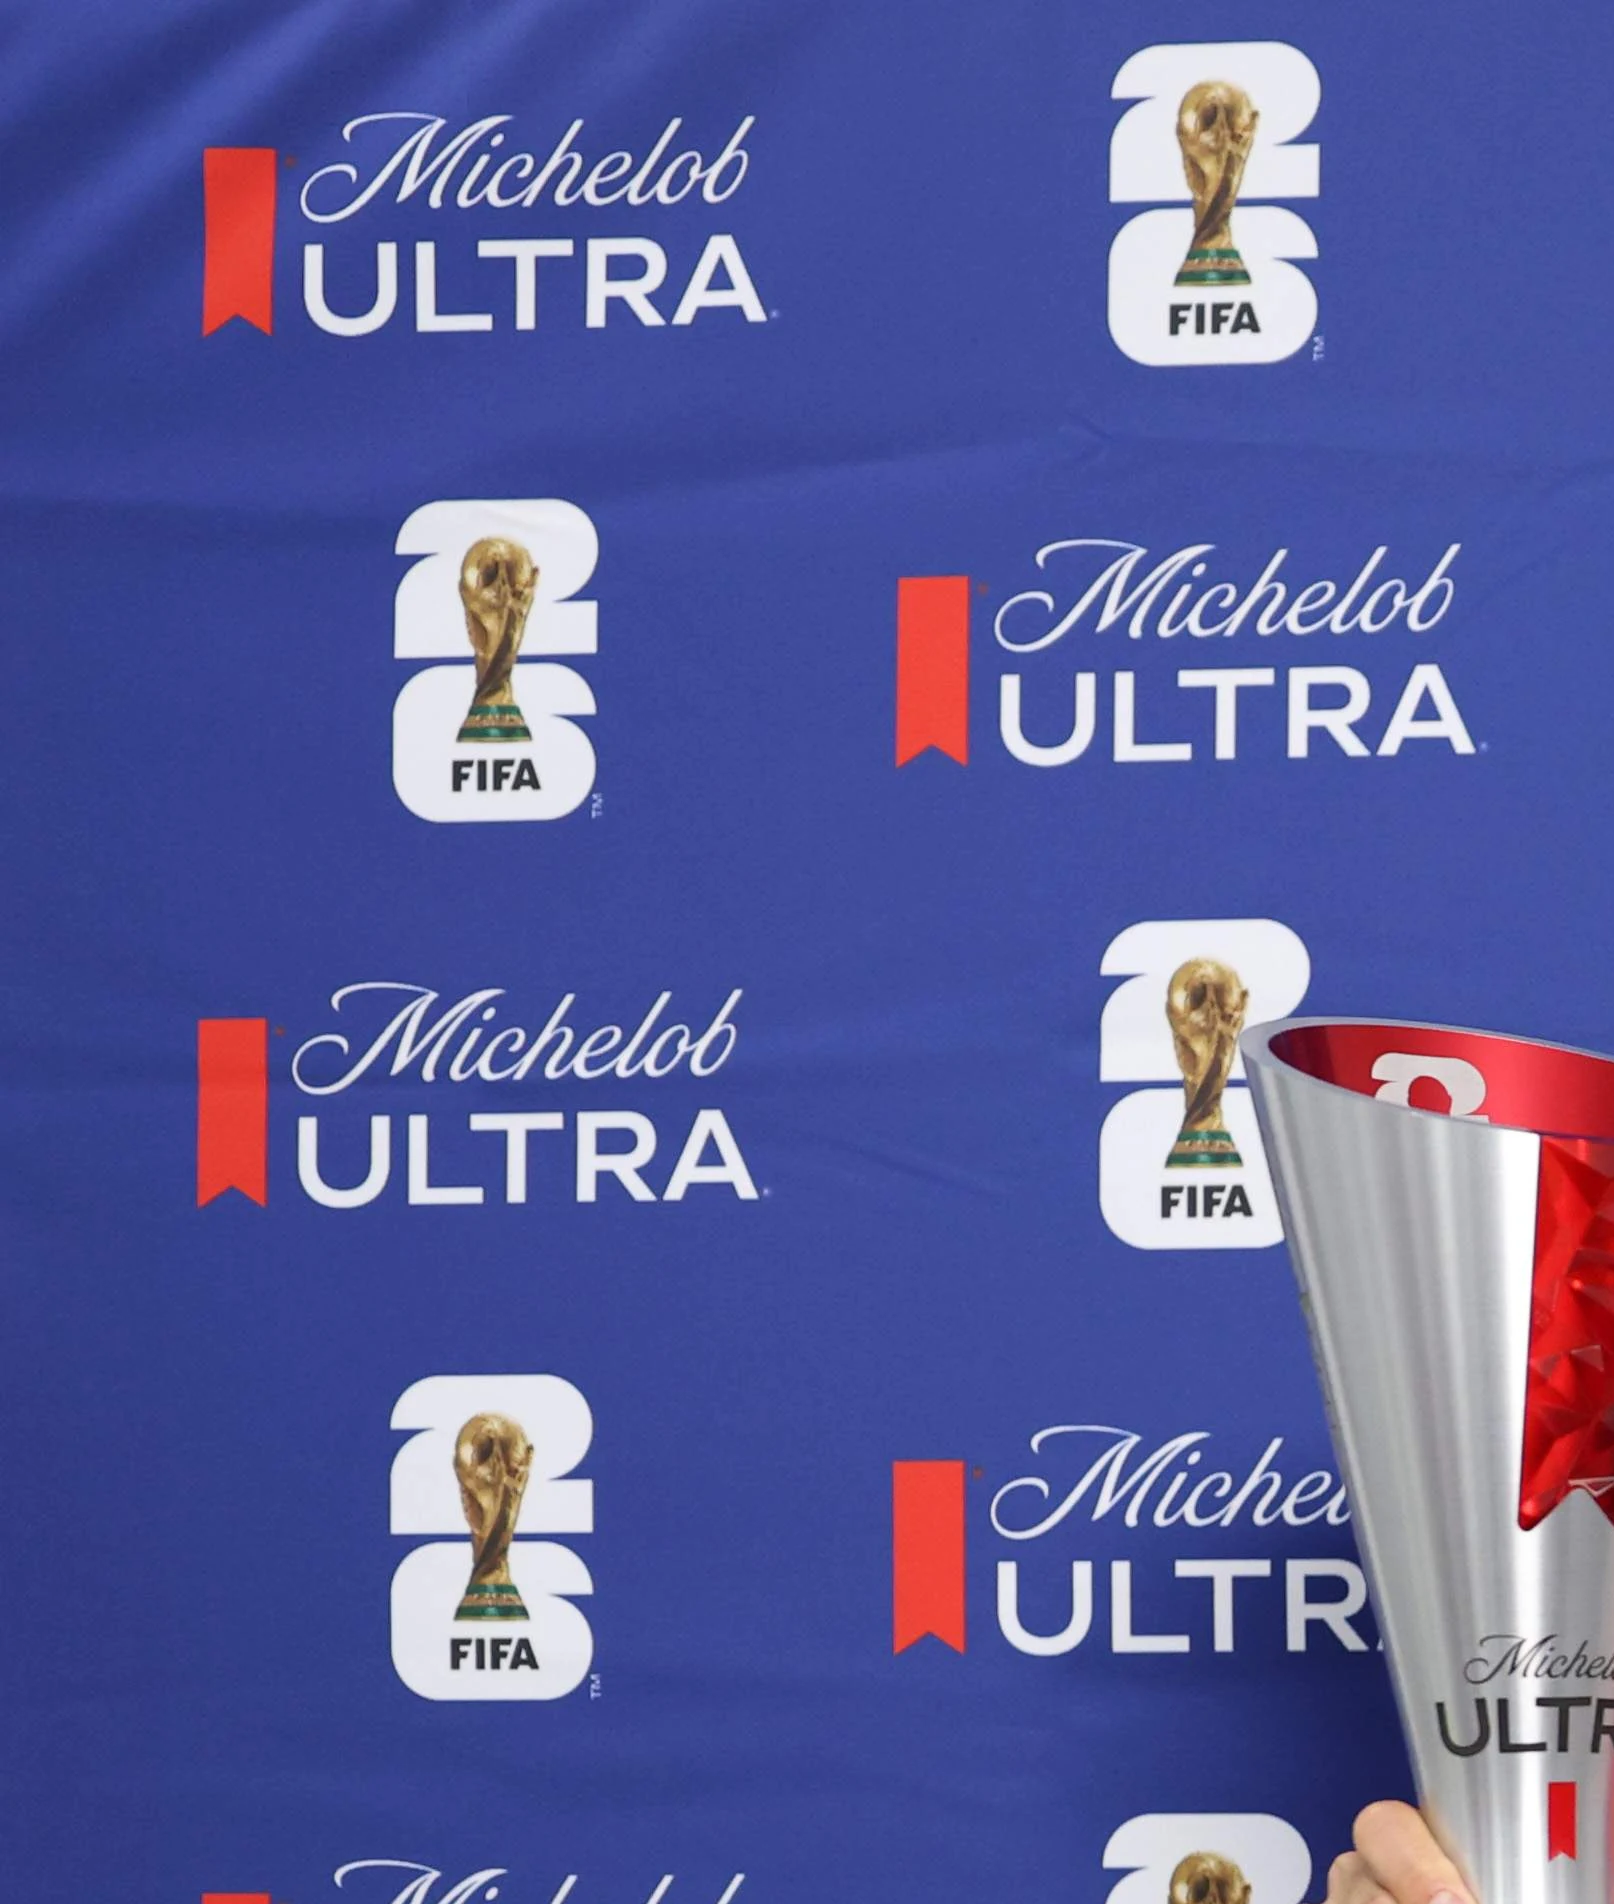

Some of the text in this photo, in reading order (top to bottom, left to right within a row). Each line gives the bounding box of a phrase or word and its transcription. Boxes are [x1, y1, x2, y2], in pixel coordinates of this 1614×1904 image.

[299, 111, 756, 224] Michelob
[302, 233, 769, 338] ULTRA
[1169, 301, 1261, 336] FIFA
[993, 538, 1462, 654] Michelob
[998, 662, 1477, 769] ULTRA
[451, 758, 542, 793] FIFA
[291, 981, 744, 1096] Michelob
[297, 1108, 760, 1210] ULTRA
[1161, 1185, 1253, 1218] FIFA
[990, 1425, 1352, 1540] Miche
[450, 1637, 540, 1671] FIFA
[997, 1558, 1386, 1657] ULTR
